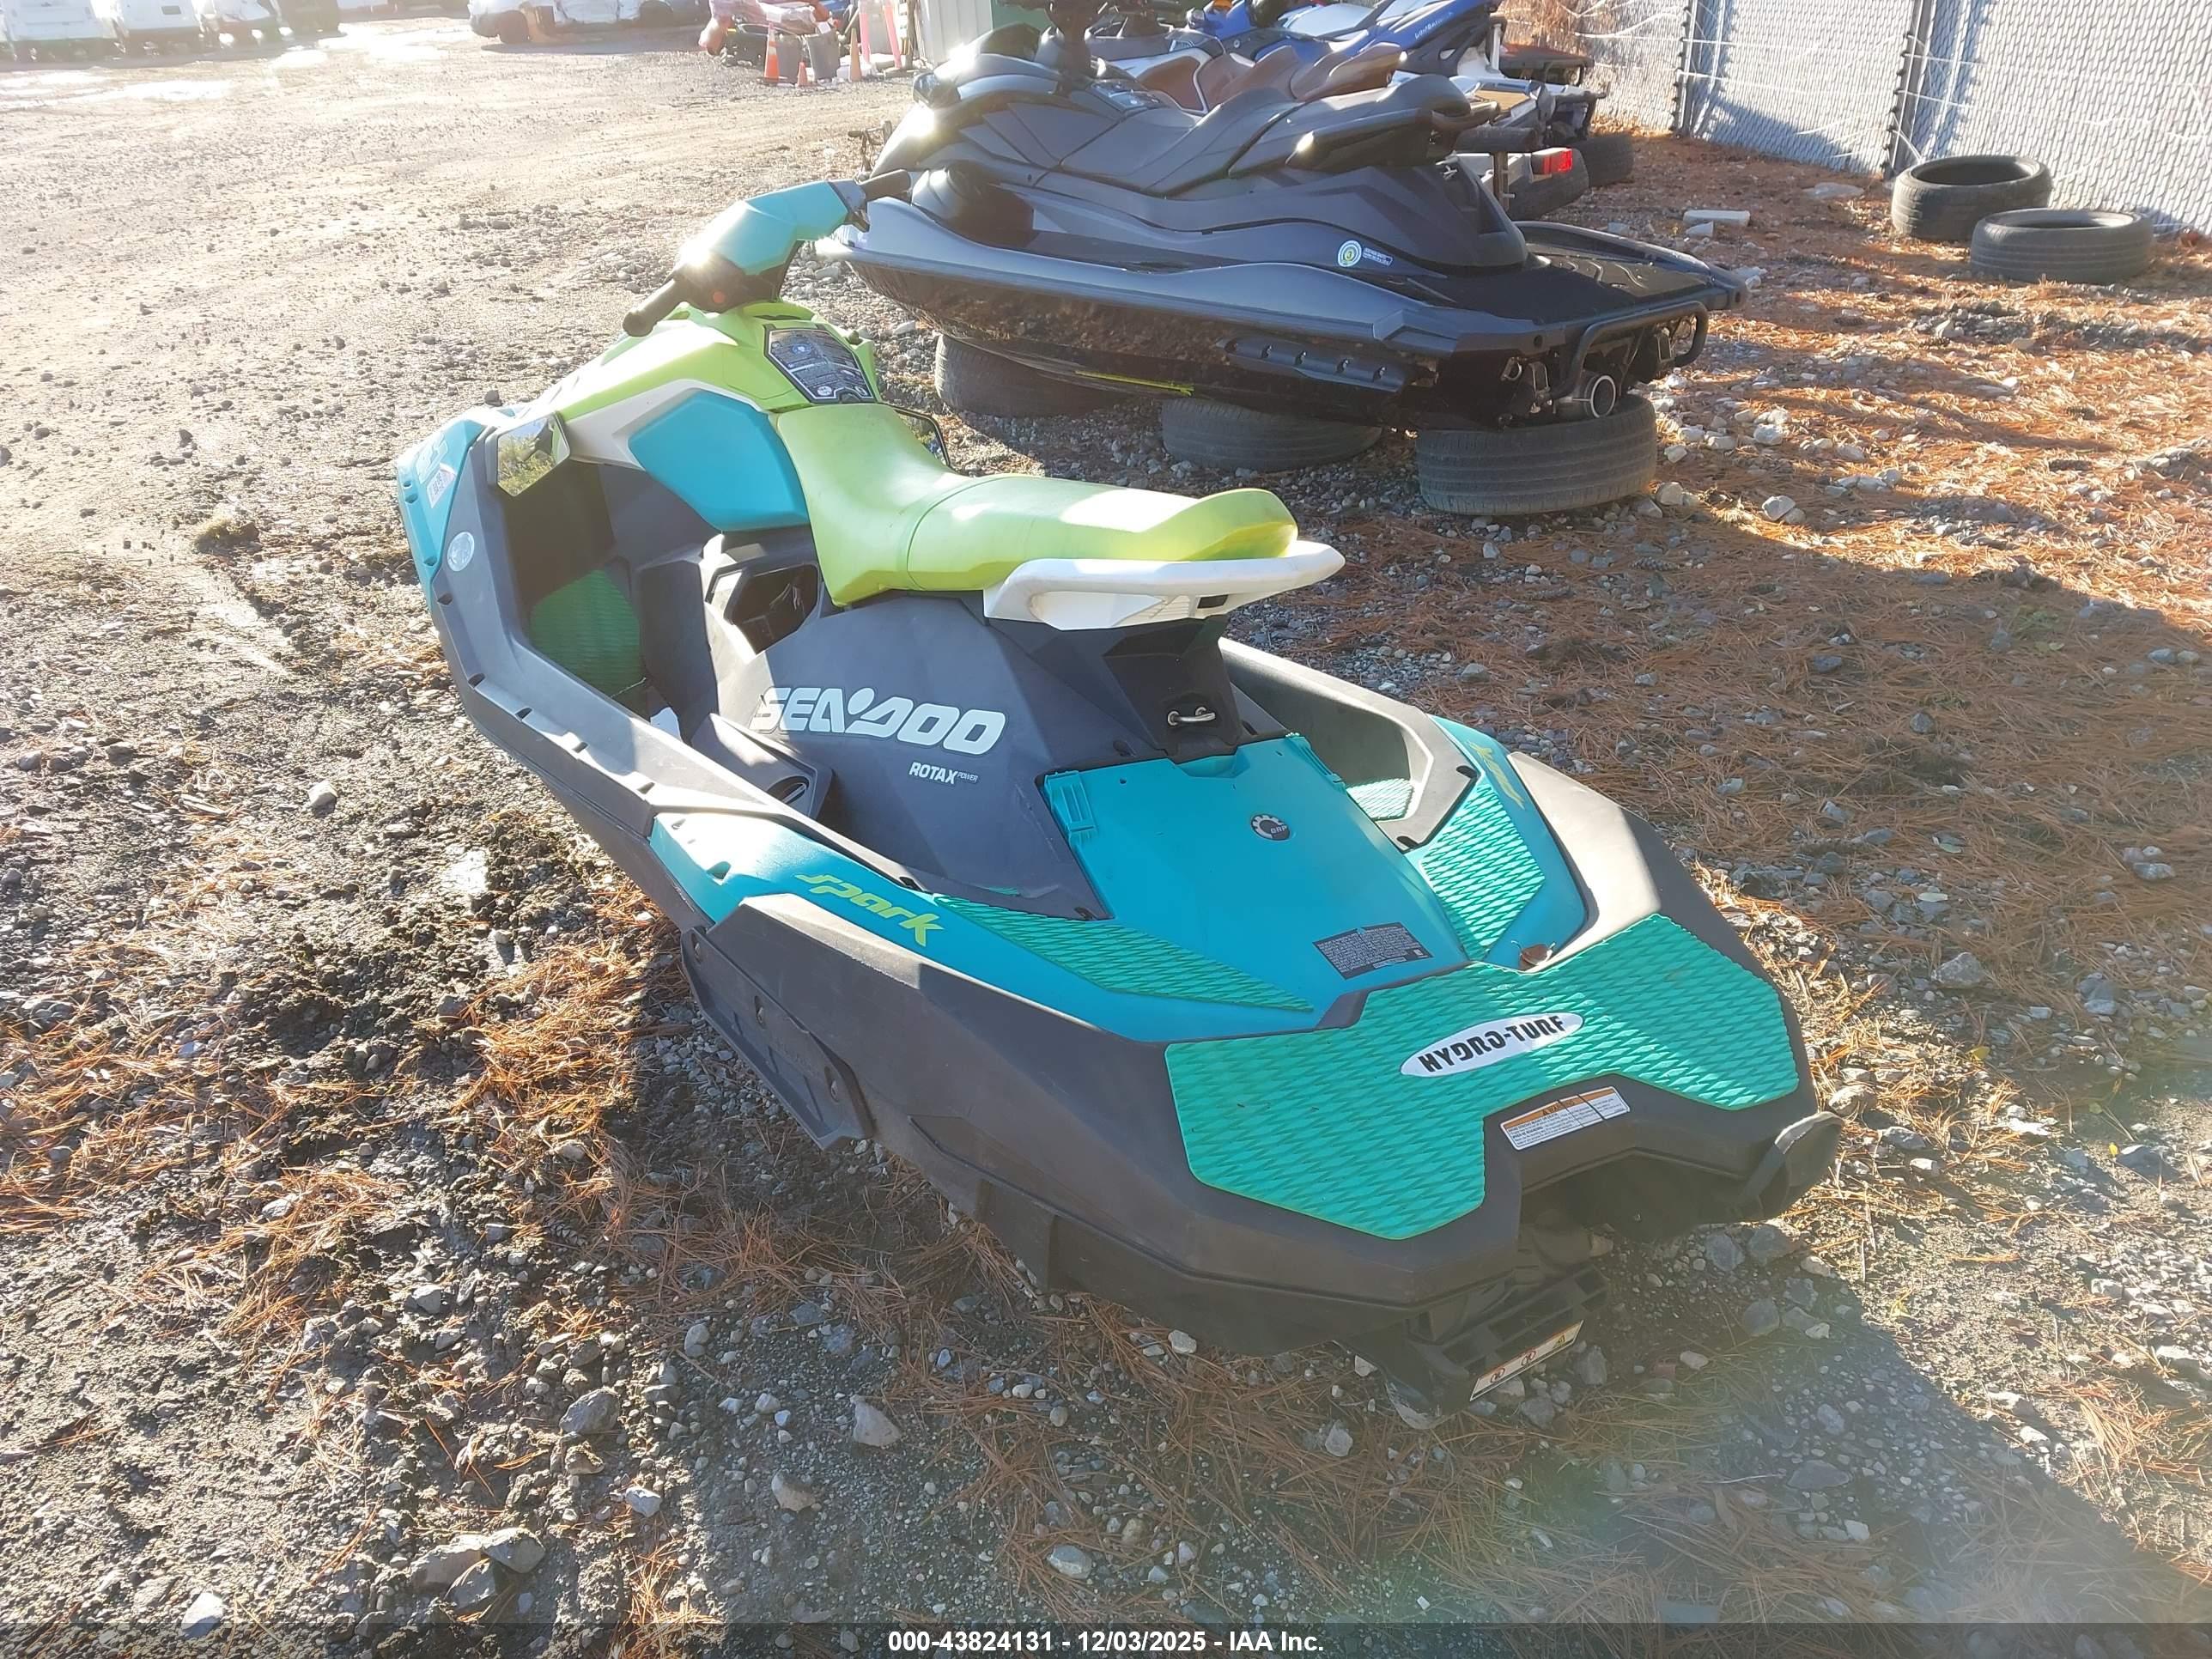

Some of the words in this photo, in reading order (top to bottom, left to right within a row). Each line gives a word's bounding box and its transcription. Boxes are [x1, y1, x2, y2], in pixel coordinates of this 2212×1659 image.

[908, 762, 958, 785] ROTAX
[957, 771, 979, 782] POWER
[1418, 1015, 1565, 1073] HYDRO-TURF
